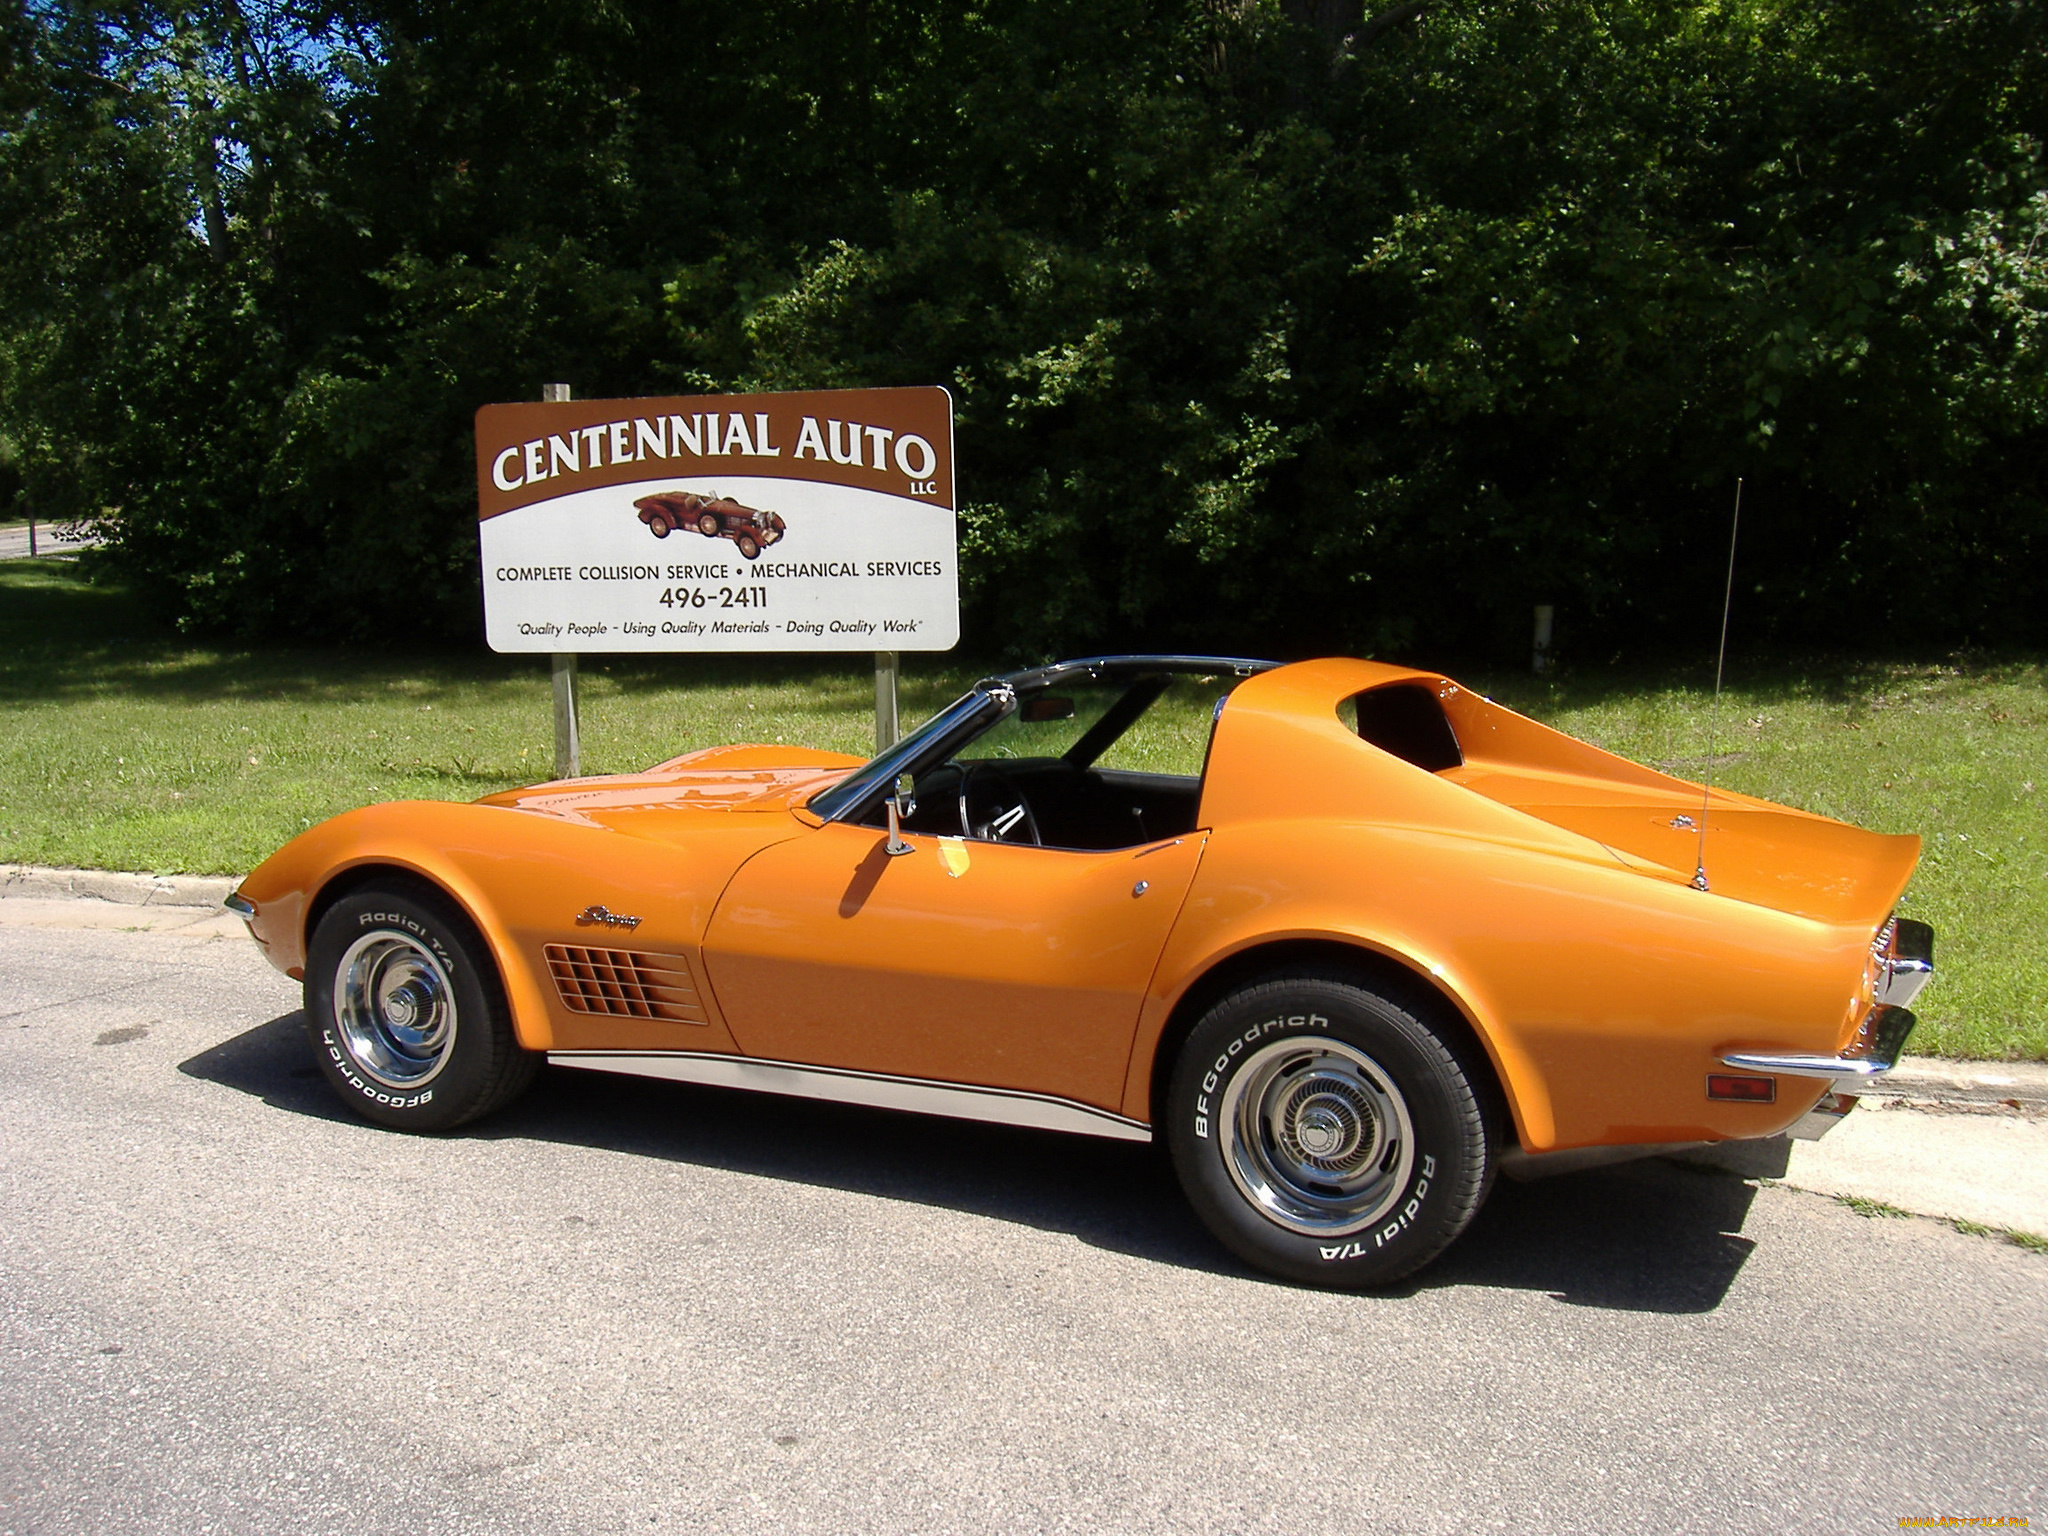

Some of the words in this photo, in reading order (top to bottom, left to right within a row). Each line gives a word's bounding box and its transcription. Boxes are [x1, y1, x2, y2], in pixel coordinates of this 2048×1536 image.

[492, 412, 780, 491] CENTENNIAL
[793, 416, 937, 479] AUTO
[910, 482, 937, 494] LLC
[496, 566, 572, 582] COMPLETE
[579, 565, 659, 580] COLLISION
[667, 565, 729, 580] SERVICE
[750, 562, 859, 578] MECHANICAL
[867, 561, 942, 576] SERVICES
[659, 587, 767, 609] 496-2411
[517, 622, 563, 637] "Quality
[568, 623, 607, 637] People
[623, 622, 656, 637] Using
[661, 621, 706, 636] Quality
[711, 621, 770, 634] Materials
[786, 621, 824, 636] Doing
[829, 620, 876, 635] Quality
[882, 620, 922, 633] Work"
[359, 913, 425, 936] Radial
[431, 938, 454, 974] T/A
[322, 1030, 433, 1108] BFGoodrich
[1195, 1014, 1329, 1138] BFGoodrich
[1376, 1155, 1436, 1247] Radial
[1319, 1245, 1366, 1260] T/A
